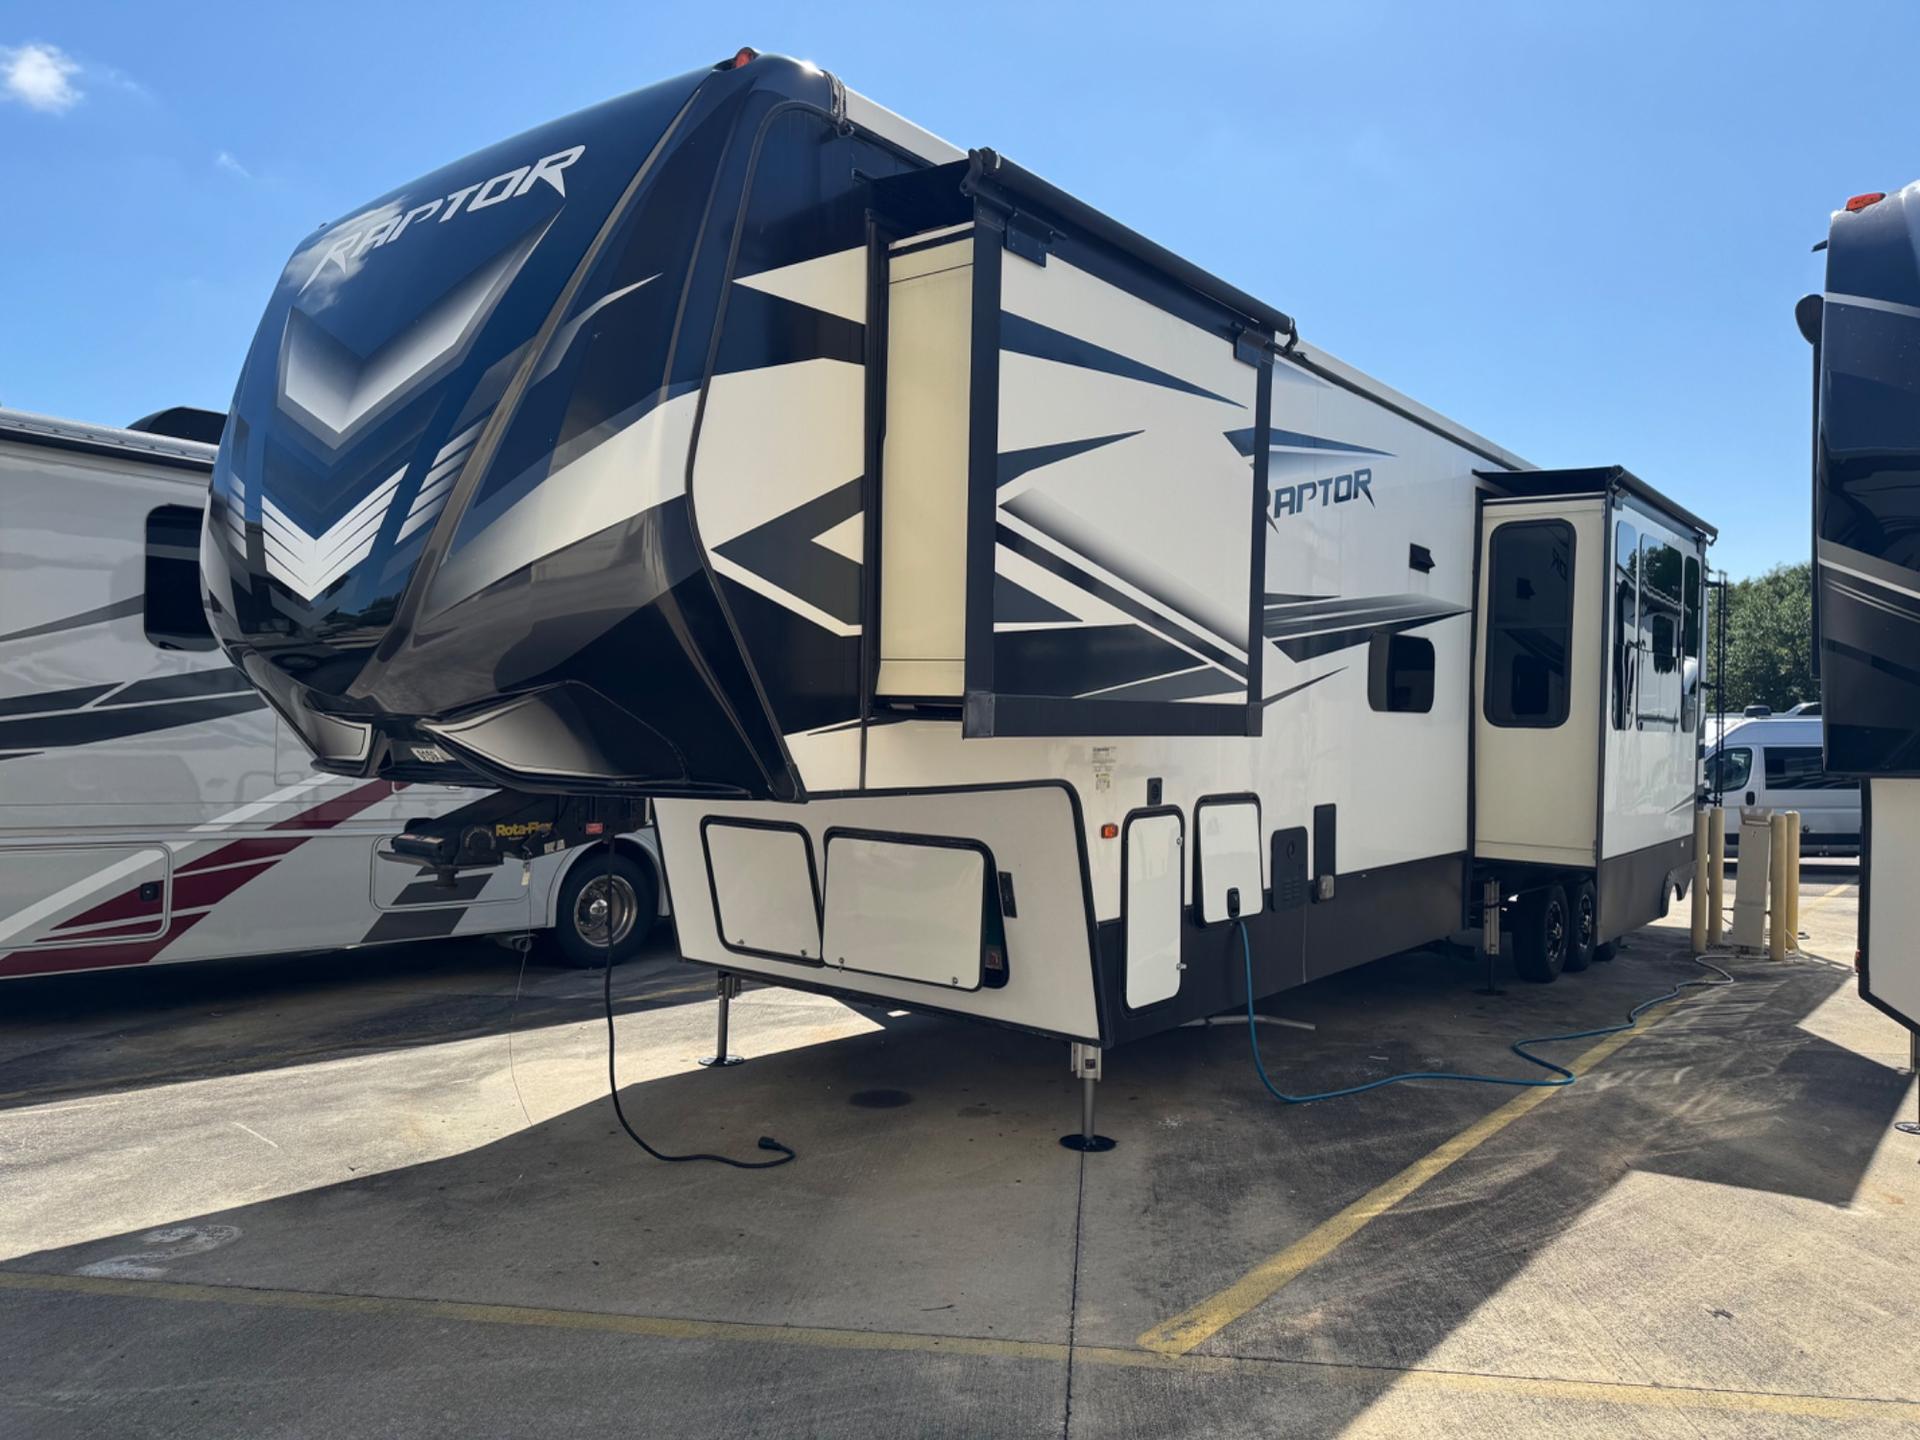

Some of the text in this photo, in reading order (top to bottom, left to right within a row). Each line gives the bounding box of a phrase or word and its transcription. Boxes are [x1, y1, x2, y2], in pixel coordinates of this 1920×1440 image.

[297, 144, 586, 296] RAPTOR
[1266, 468, 1376, 533] APTOR
[496, 822, 554, 837] Rota-F
